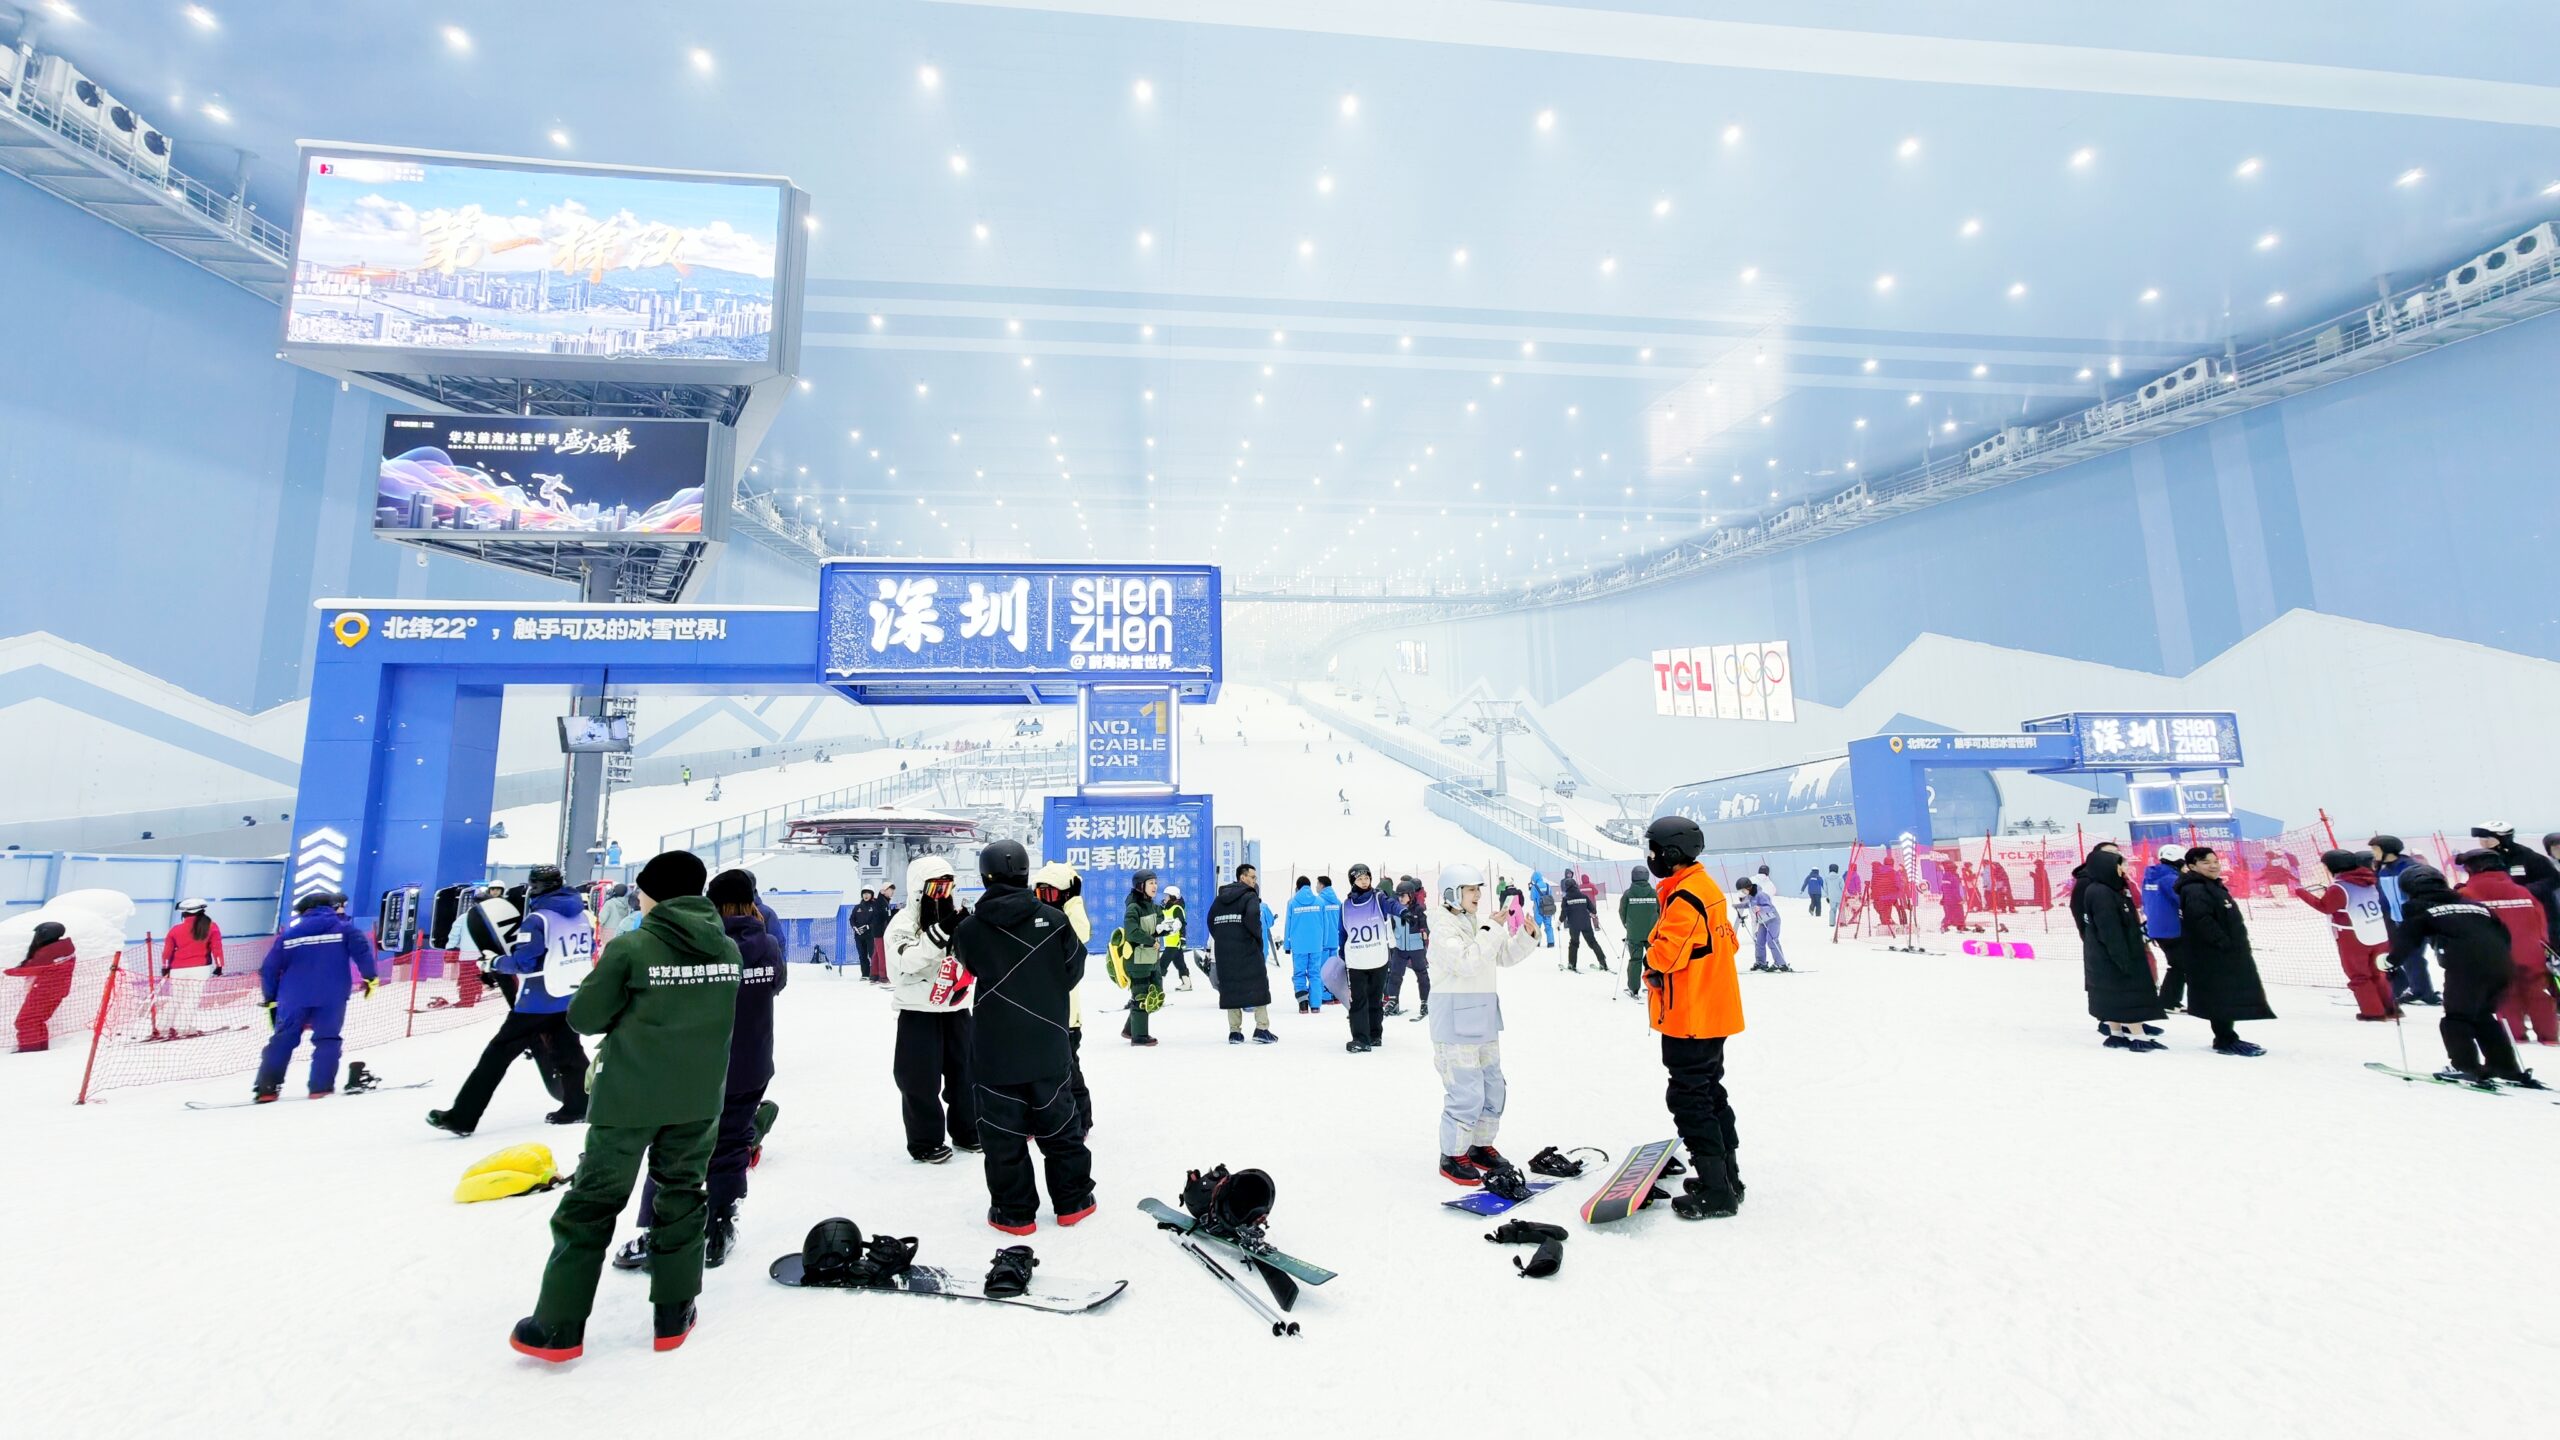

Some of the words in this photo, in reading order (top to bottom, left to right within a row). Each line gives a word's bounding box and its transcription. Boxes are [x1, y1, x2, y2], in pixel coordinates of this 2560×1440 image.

[869, 576, 1031, 653] 深圳
[1653, 660, 1713, 692] TCL
[1089, 738, 1167, 751] CABLE
[2092, 718, 2160, 754] 深圳
[1089, 754, 1139, 767] CAR
[1066, 815, 1191, 840] 来深圳体验
[1820, 813, 1853, 827] 2号索道
[1066, 846, 1175, 871] 四季畅滑!
[559, 932, 589, 957] 125
[1350, 923, 1380, 944] 201
[649, 978, 675, 986] HUAFA
[678, 977, 704, 985] SNOW
[1602, 1141, 1669, 1201] SALOMON
